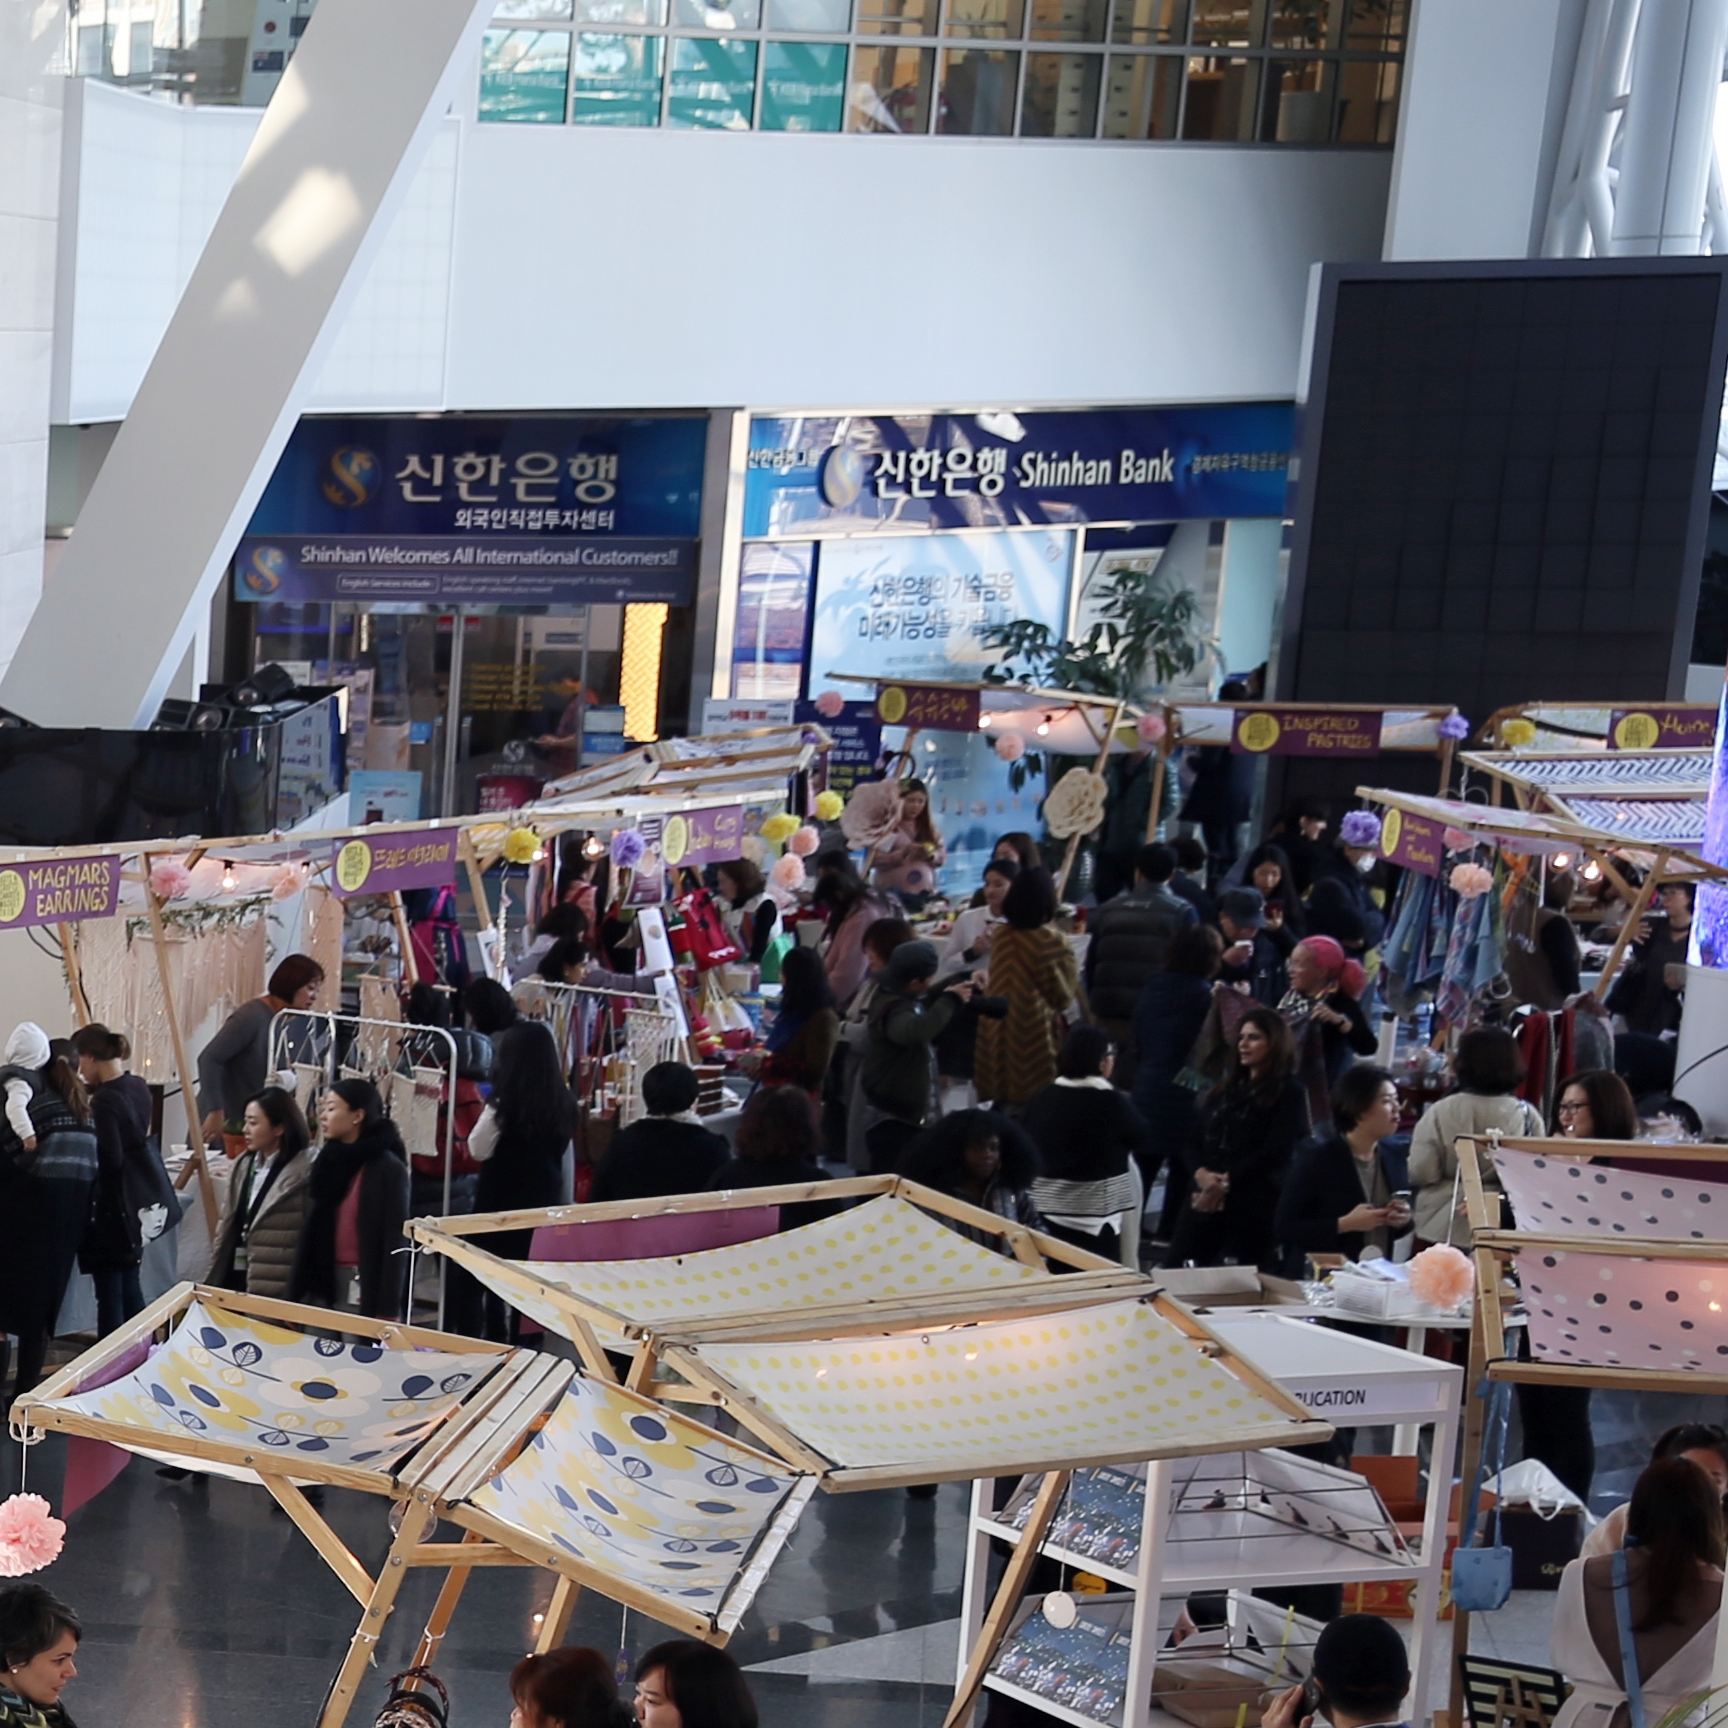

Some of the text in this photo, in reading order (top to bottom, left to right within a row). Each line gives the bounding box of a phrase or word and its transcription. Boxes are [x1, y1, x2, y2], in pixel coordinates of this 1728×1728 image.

[394, 452, 619, 503] 신한은행
[874, 446, 1175, 499] 신한은행 Shinhan Bank
[454, 509, 615, 530] 외국인직접투자센터
[300, 545, 366, 565] Shinhan
[368, 546, 450, 565] Welcomes
[451, 546, 473, 565] All
[475, 547, 579, 566] International
[28, 861, 110, 890] MAGMARS
[36, 886, 109, 917] EARRINGS
